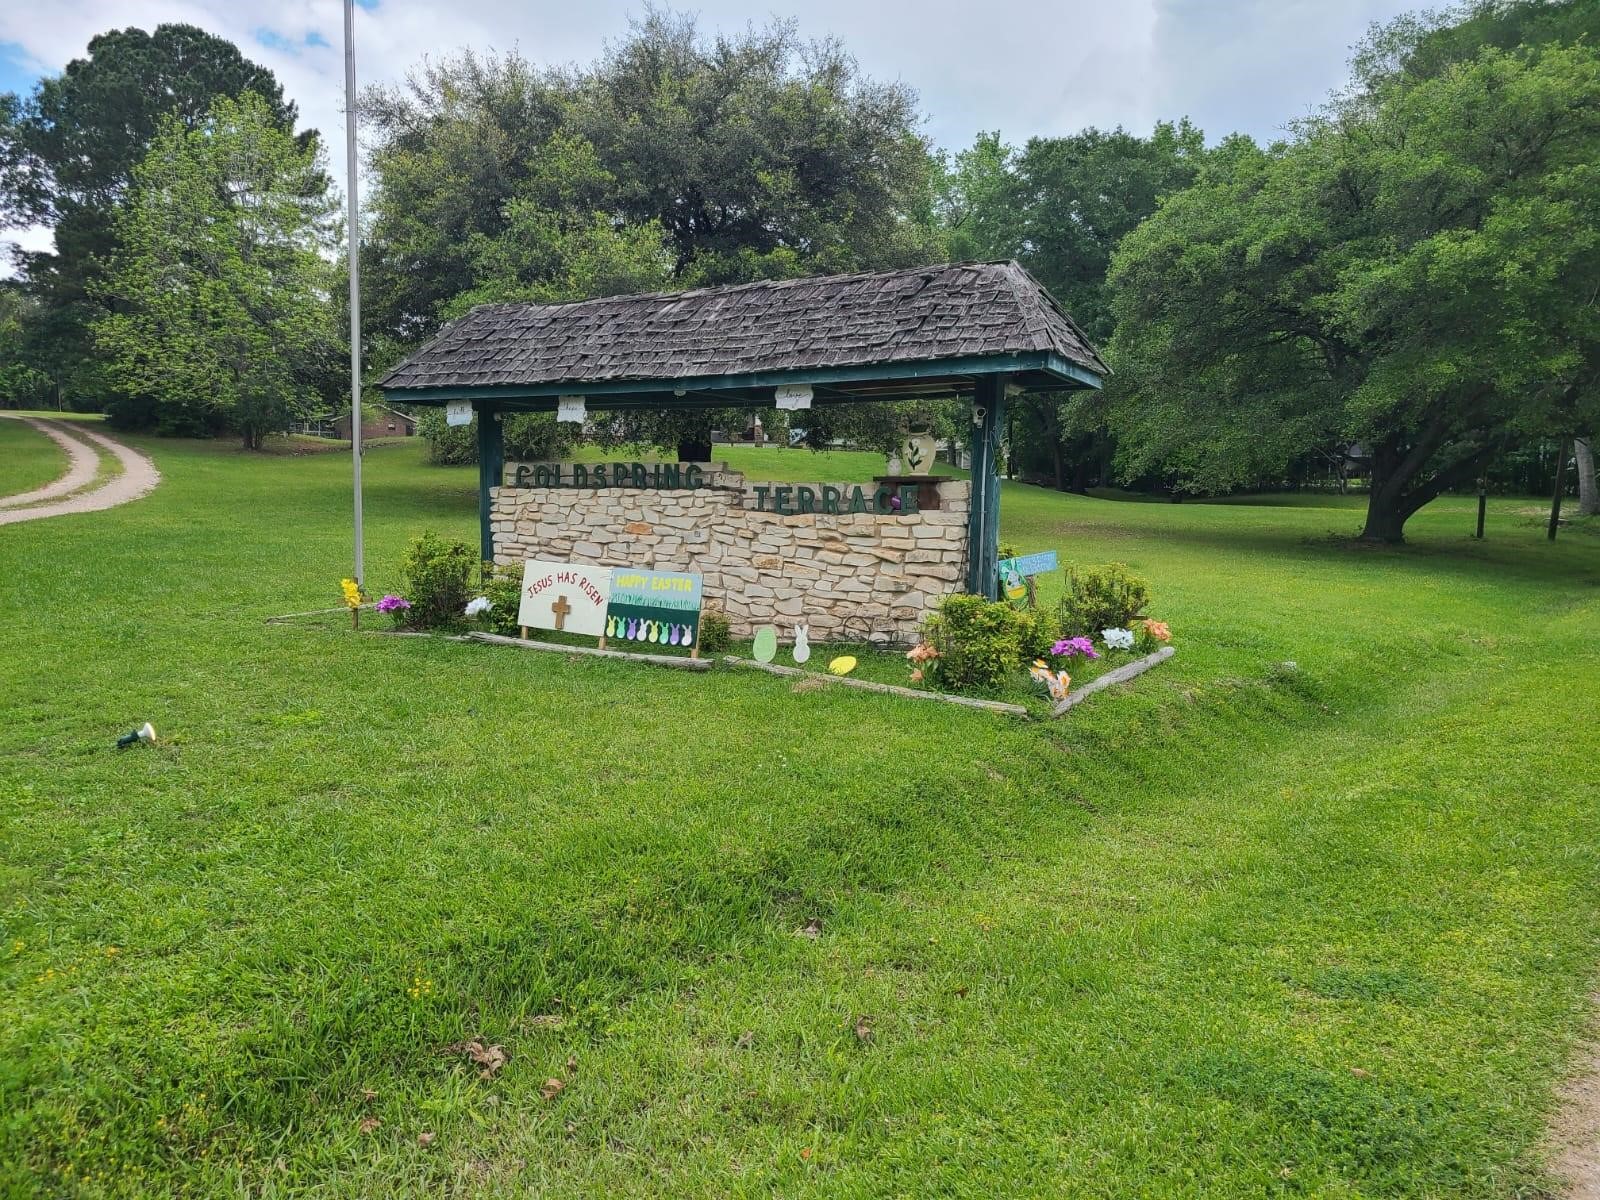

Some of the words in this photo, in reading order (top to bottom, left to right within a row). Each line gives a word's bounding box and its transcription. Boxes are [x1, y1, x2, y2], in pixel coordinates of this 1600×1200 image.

[516, 463, 704, 490] COLDSPRING
[753, 486, 920, 515] TERRACE
[528, 574, 553, 599] JESUS
[557, 571, 578, 585] HAS
[579, 577, 604, 607] RISEN
[616, 575, 648, 589] HAPPY
[651, 576, 693, 592] EASTER
